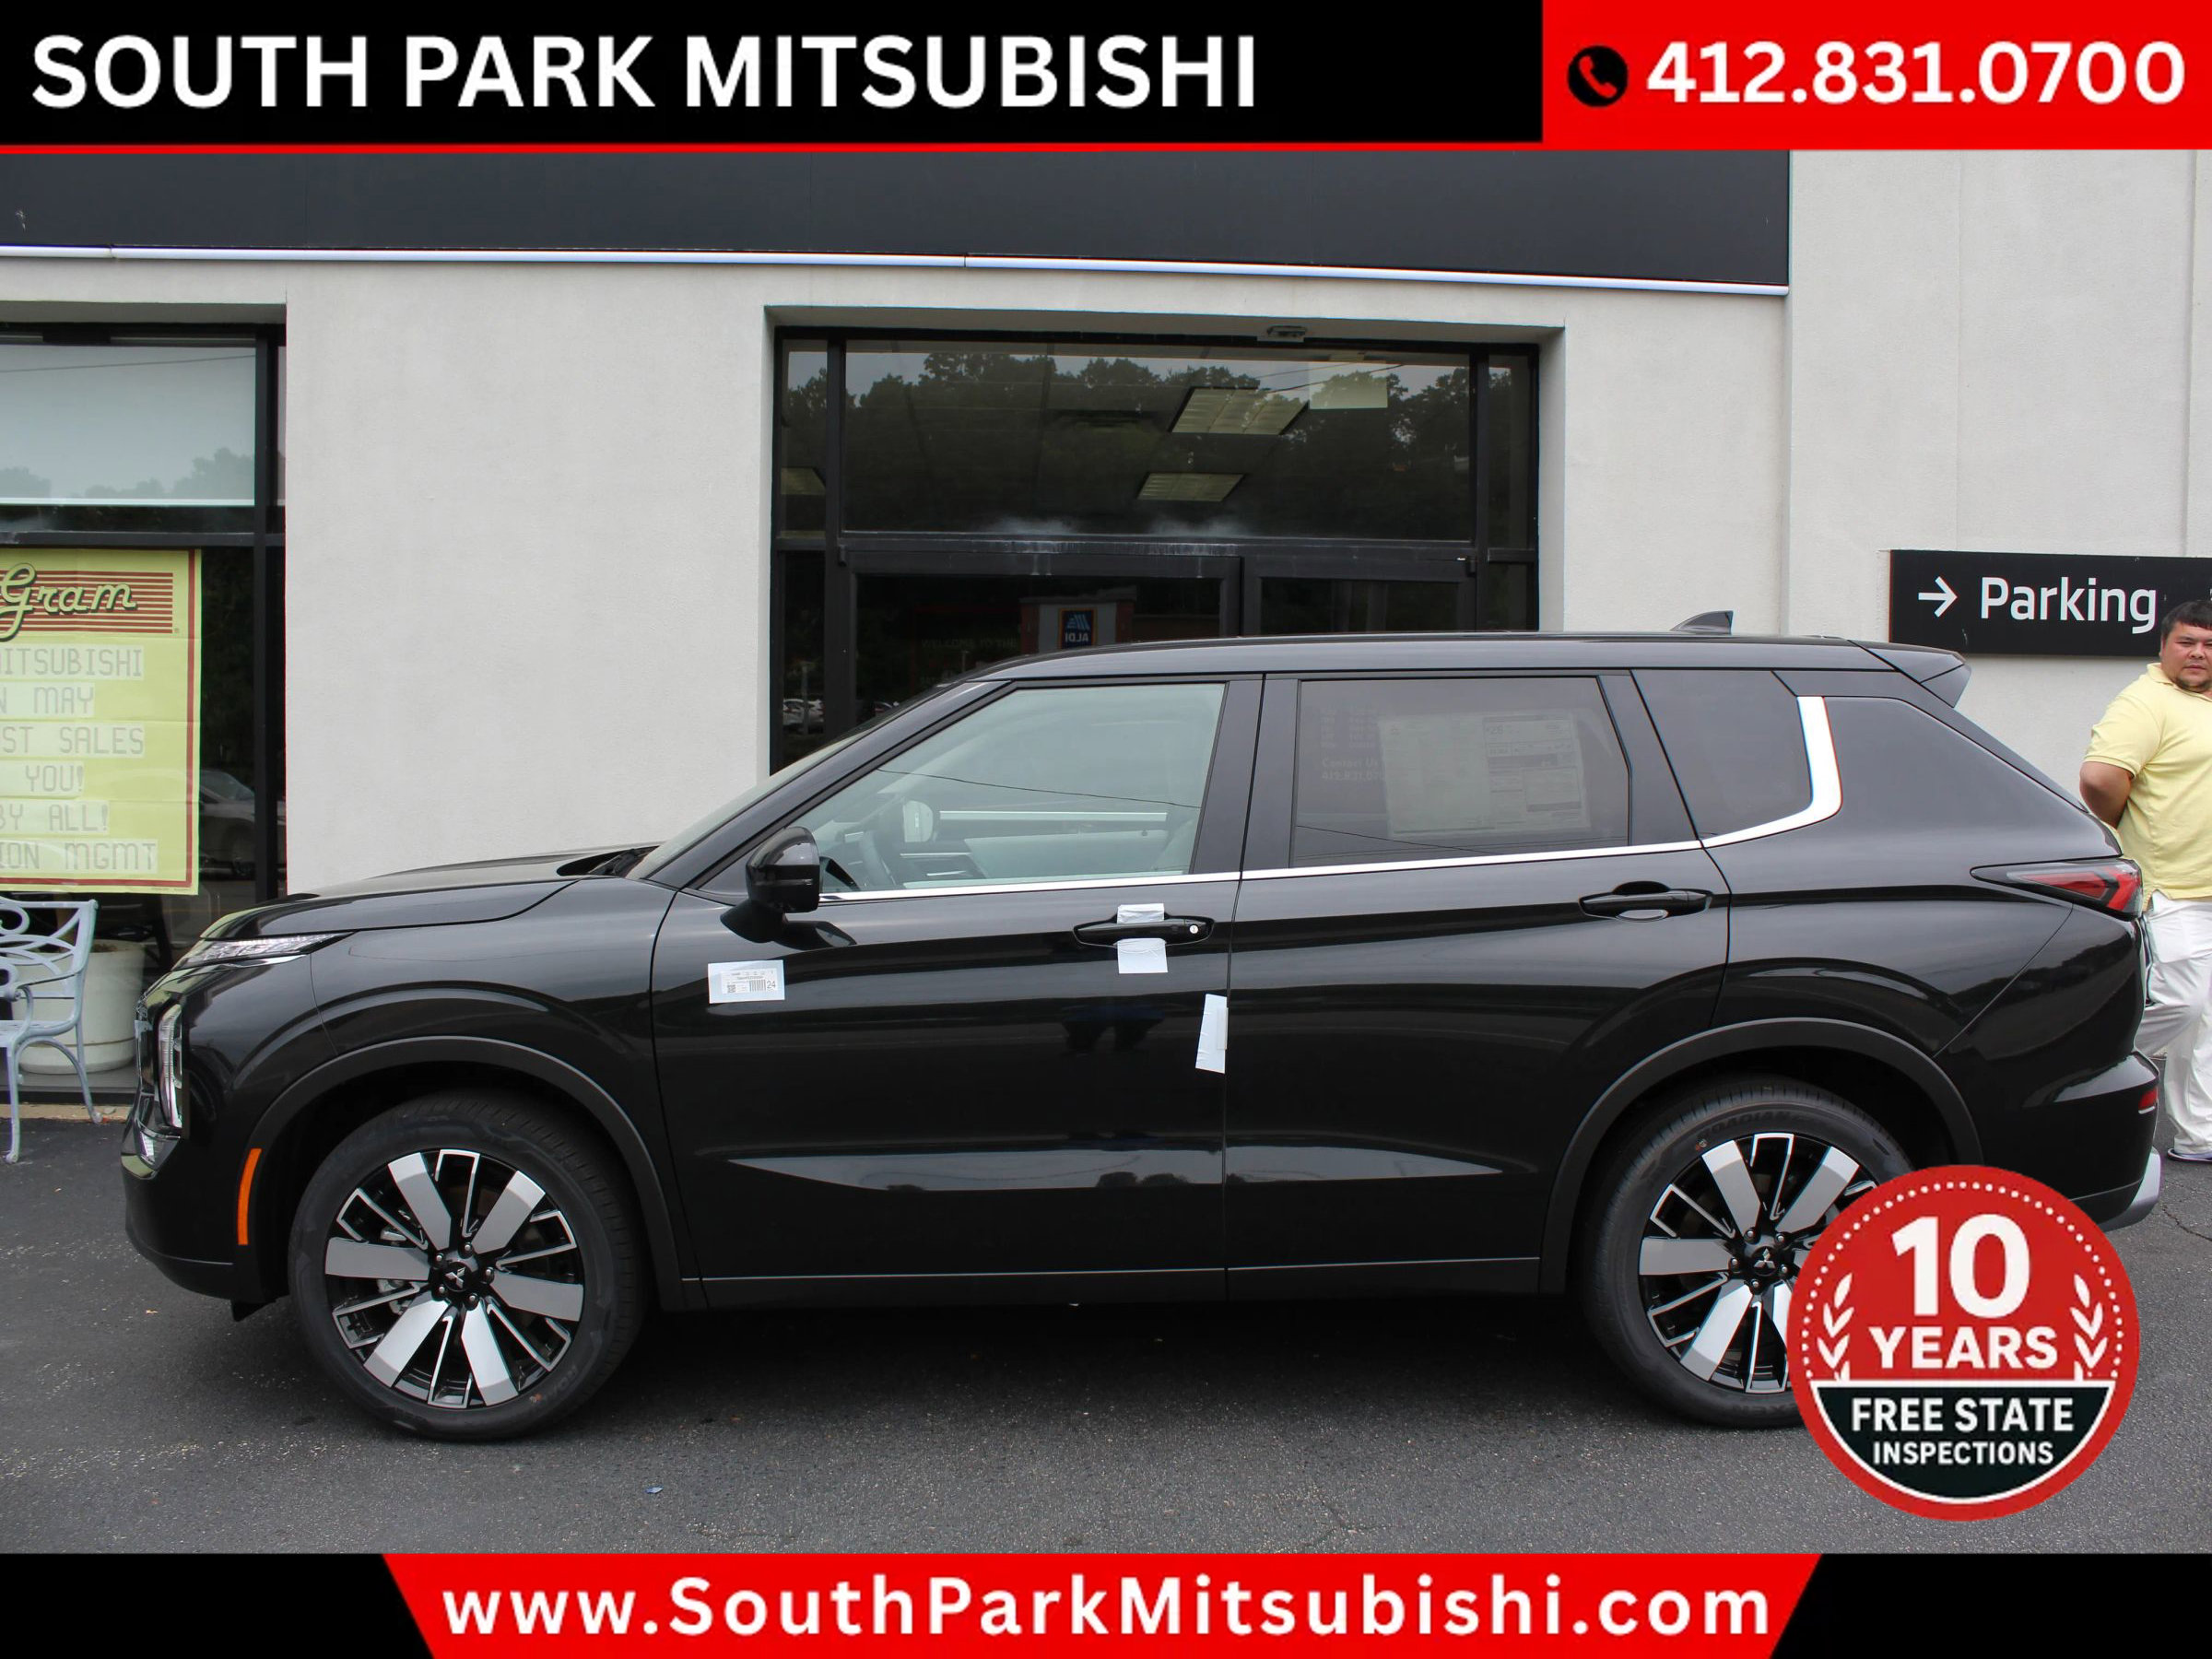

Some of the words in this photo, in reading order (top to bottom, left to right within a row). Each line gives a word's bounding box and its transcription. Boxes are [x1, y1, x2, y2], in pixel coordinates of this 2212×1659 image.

[1981, 576, 2157, 634] Parking
[0, 647, 142, 677] ITSUBISHI
[33, 686, 94, 714] MAY
[59, 726, 145, 755] SALES
[25, 764, 85, 793] YOU!
[48, 804, 109, 832] ALL!
[65, 842, 157, 871] MGMT
